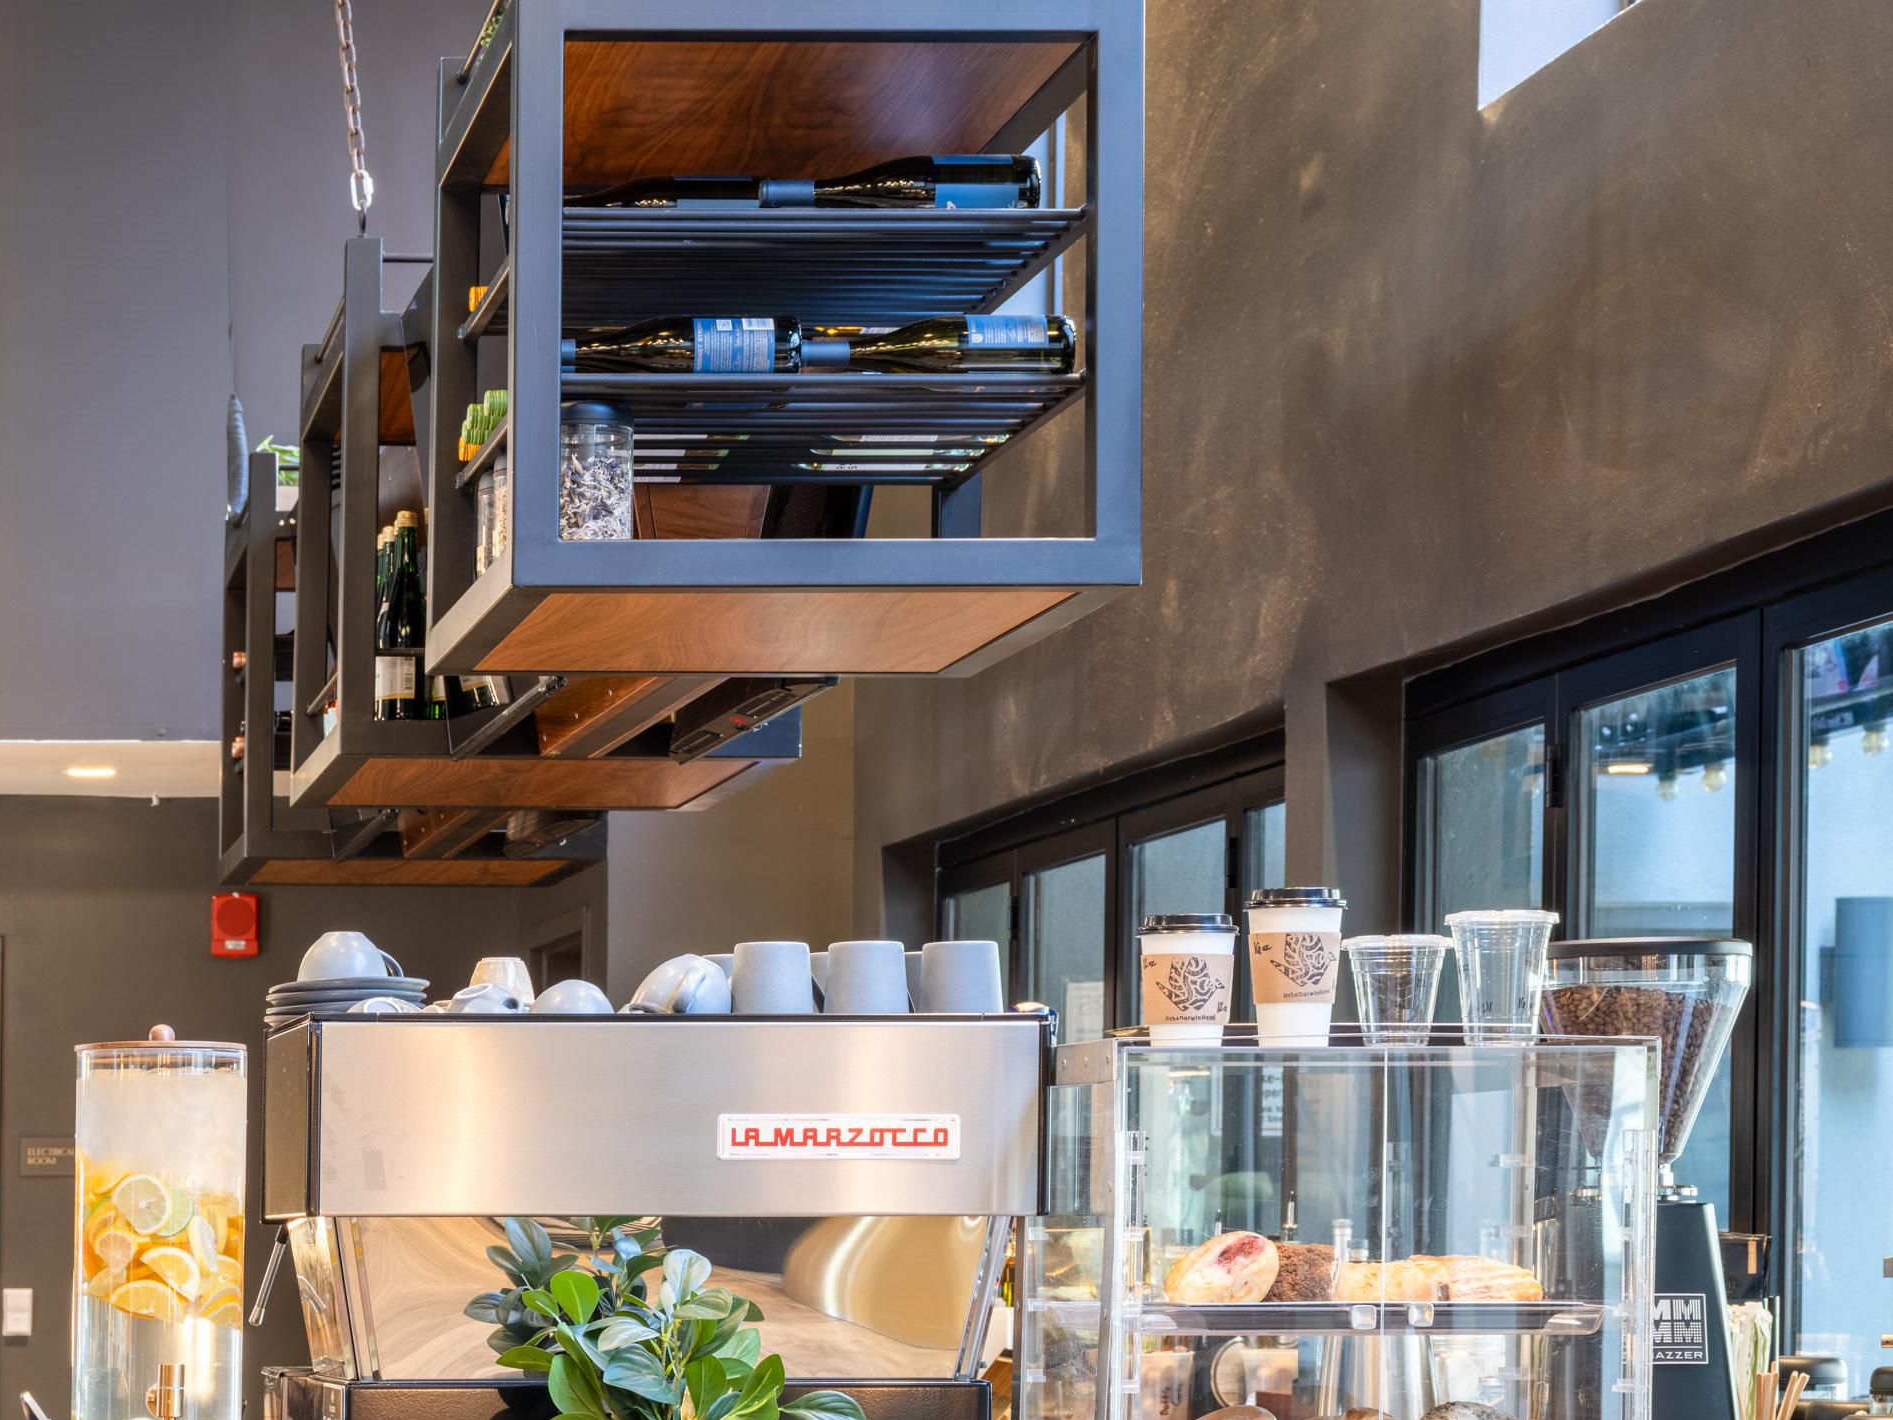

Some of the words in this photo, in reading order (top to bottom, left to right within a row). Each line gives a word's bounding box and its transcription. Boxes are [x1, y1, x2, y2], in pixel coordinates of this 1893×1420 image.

[731, 1127, 760, 1147] LA
[774, 1127, 949, 1147] MARZOCCO
[26, 1147, 74, 1156] ELECTRICA
[26, 1157, 56, 1165] ROOM
[1653, 1351, 1704, 1359] AZZER
